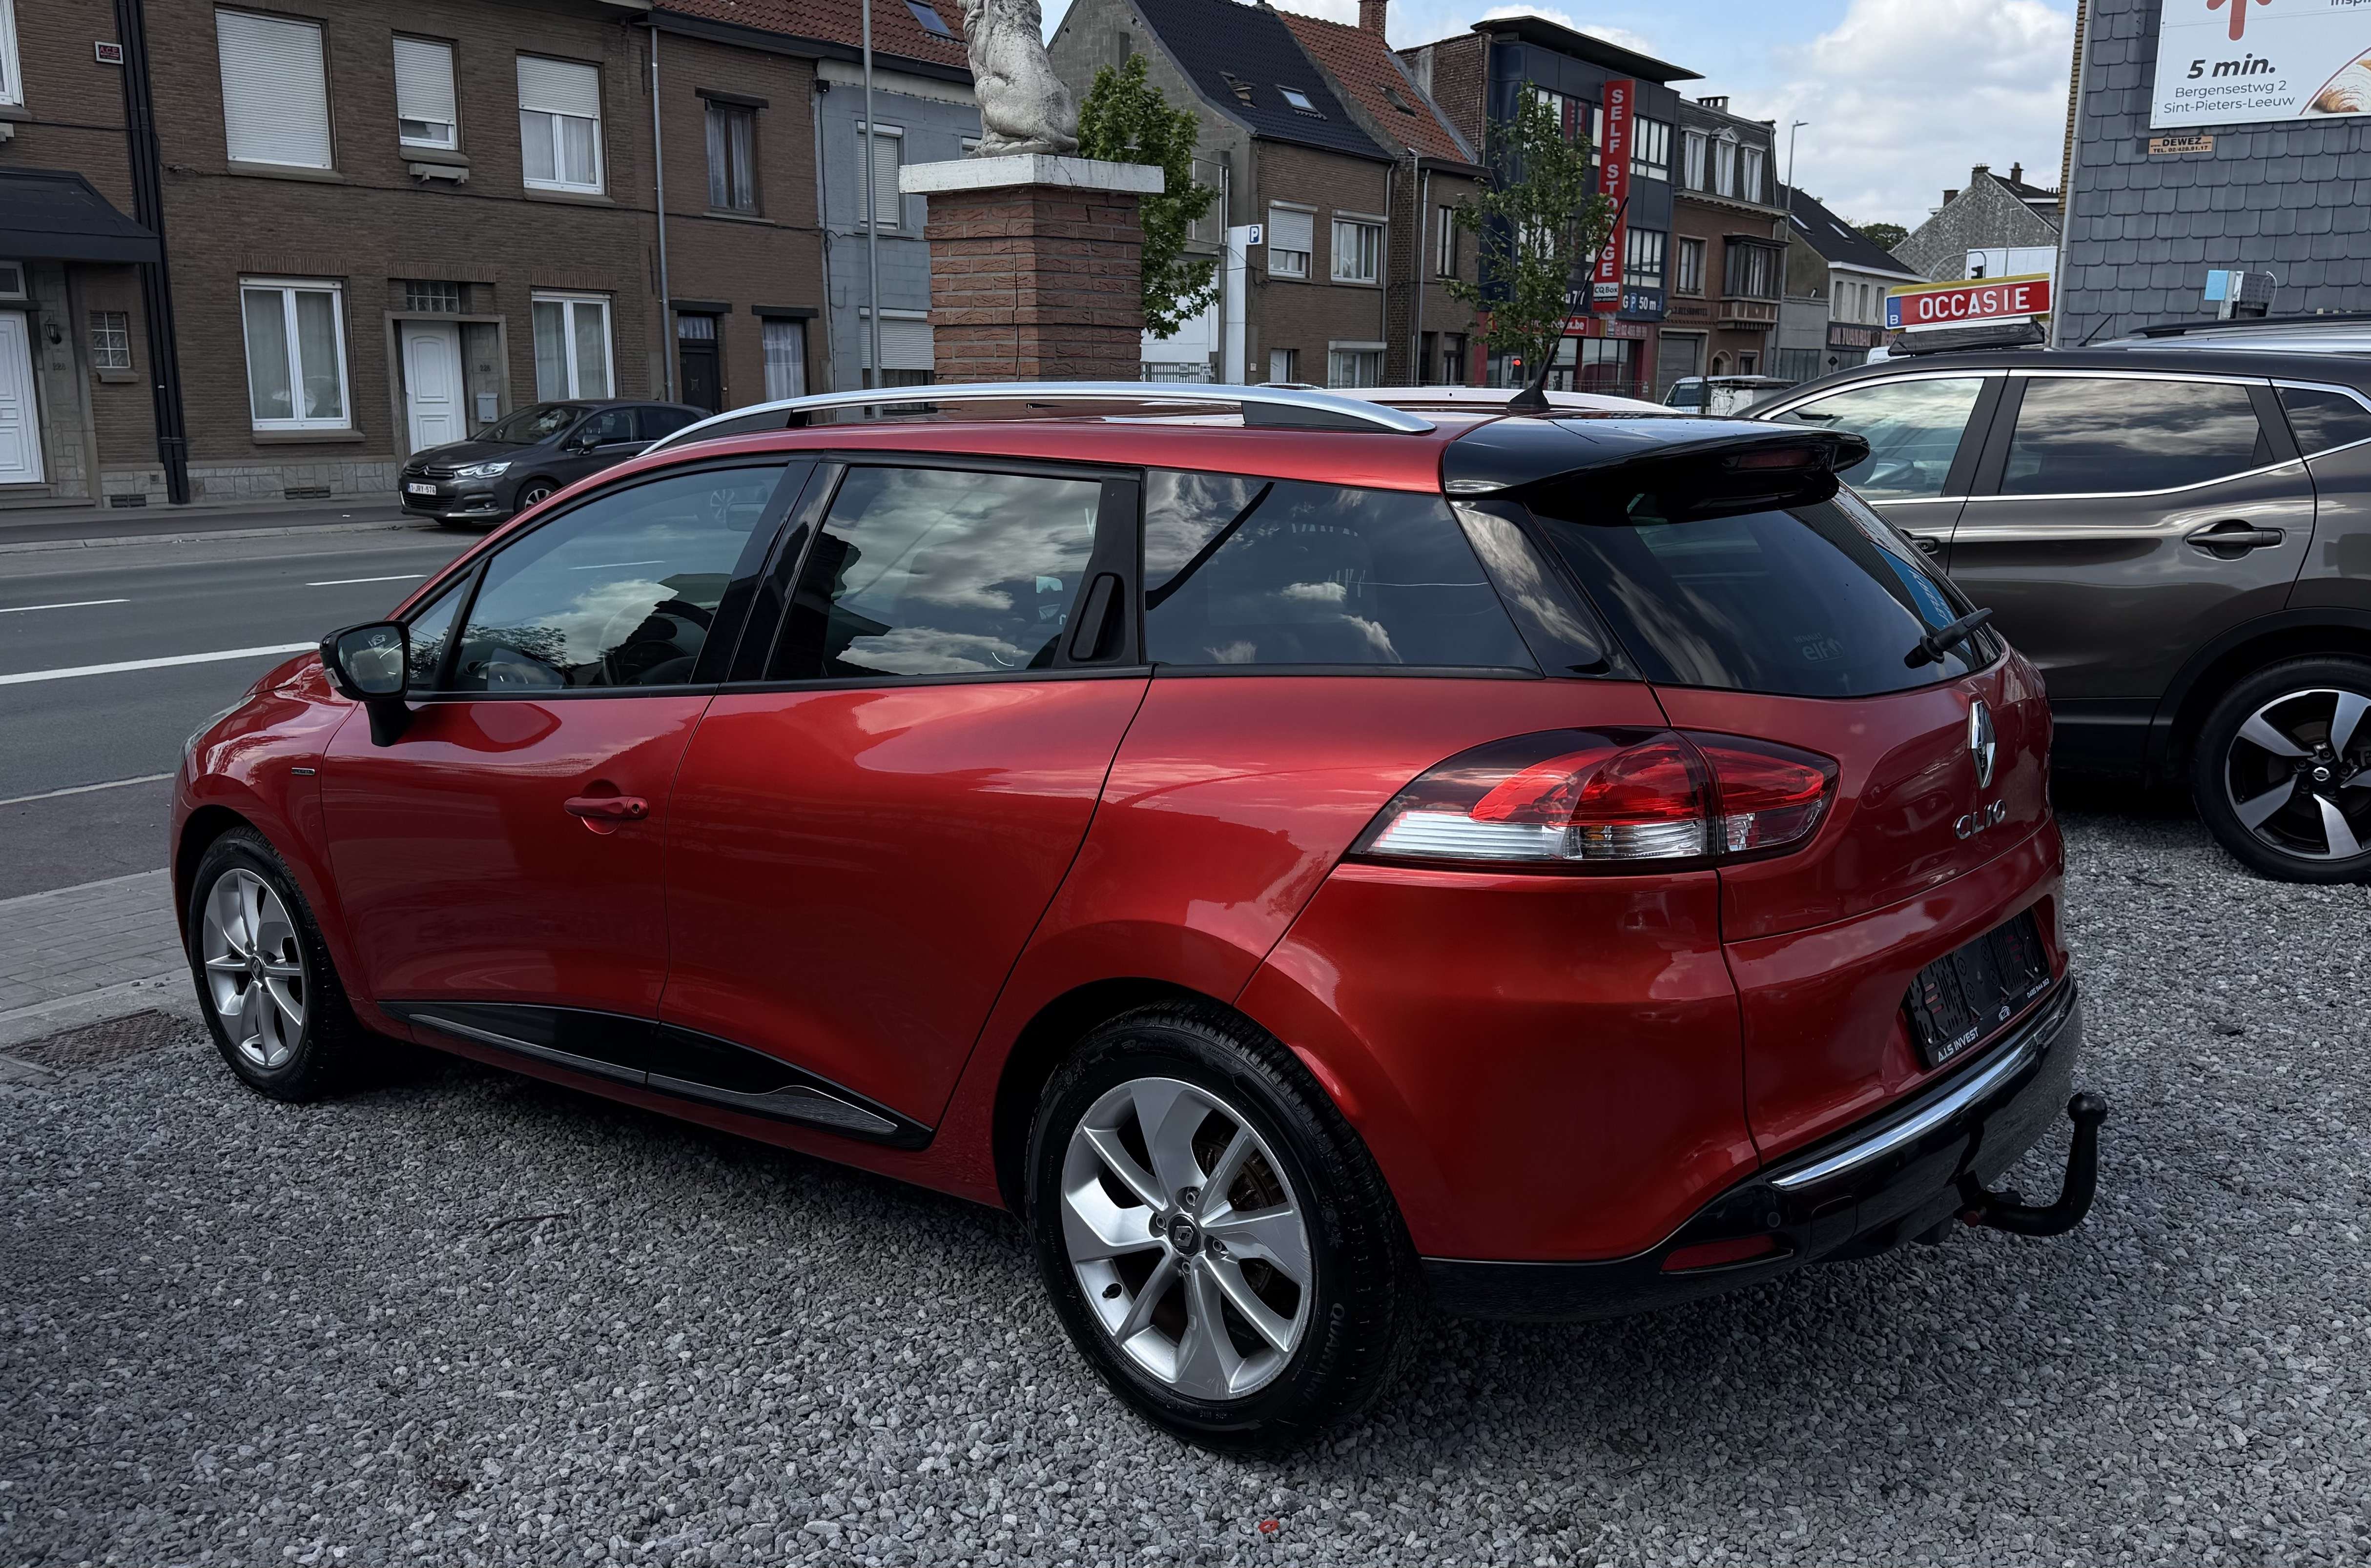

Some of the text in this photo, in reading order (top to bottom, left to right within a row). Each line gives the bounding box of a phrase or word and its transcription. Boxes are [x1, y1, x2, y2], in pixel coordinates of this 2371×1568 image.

[2187, 53, 2276, 79] 5 min.
[2175, 80, 2287, 99] Bergensestwg 2
[2164, 97, 2295, 113] Sint-Pieters-Leeuw
[1609, 89, 1624, 154] SELF
[2162, 137, 2202, 146] DEWEZ
[1251, 227, 1258, 242] P
[1639, 296, 1649, 310] 50
[1649, 300, 1656, 311] m
[1919, 287, 2030, 320] OCCASIE
[1890, 315, 1898, 325] B
[1954, 799, 2007, 840] CLIO
[1954, 1026, 1979, 1051] INVEST
